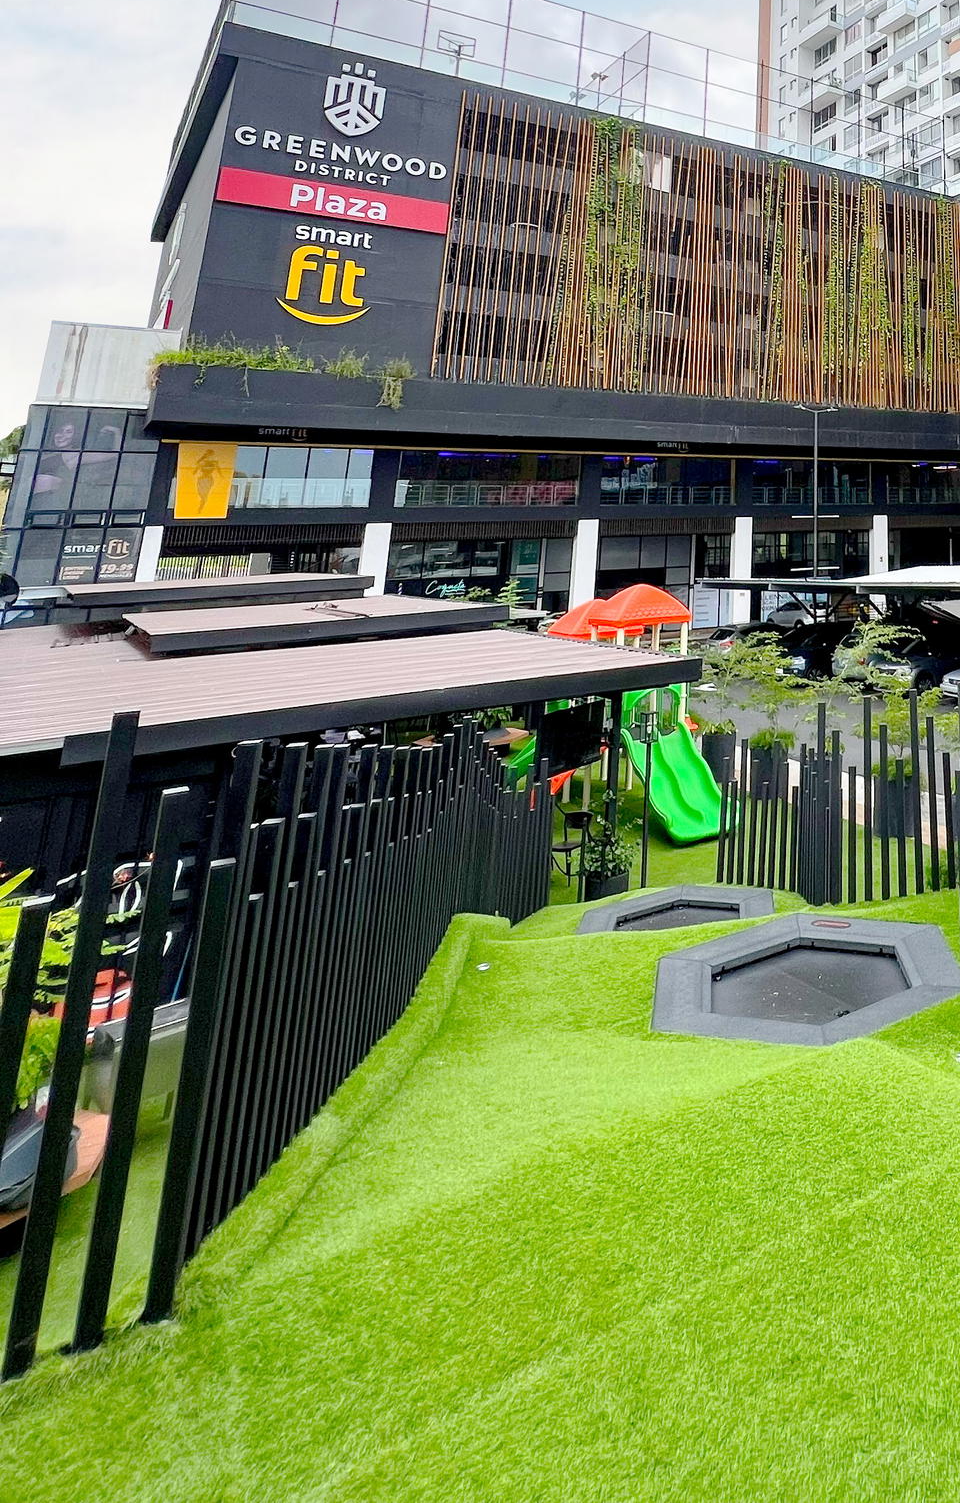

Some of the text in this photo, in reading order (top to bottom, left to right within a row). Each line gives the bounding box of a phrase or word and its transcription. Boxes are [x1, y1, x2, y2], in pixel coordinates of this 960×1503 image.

[234, 126, 448, 181] GREENWOOD
[293, 159, 392, 187] DISTRICT
[289, 184, 388, 221] Plaza
[295, 224, 374, 250] smart
[285, 245, 367, 307] fit
[63, 543, 107, 554] smart
